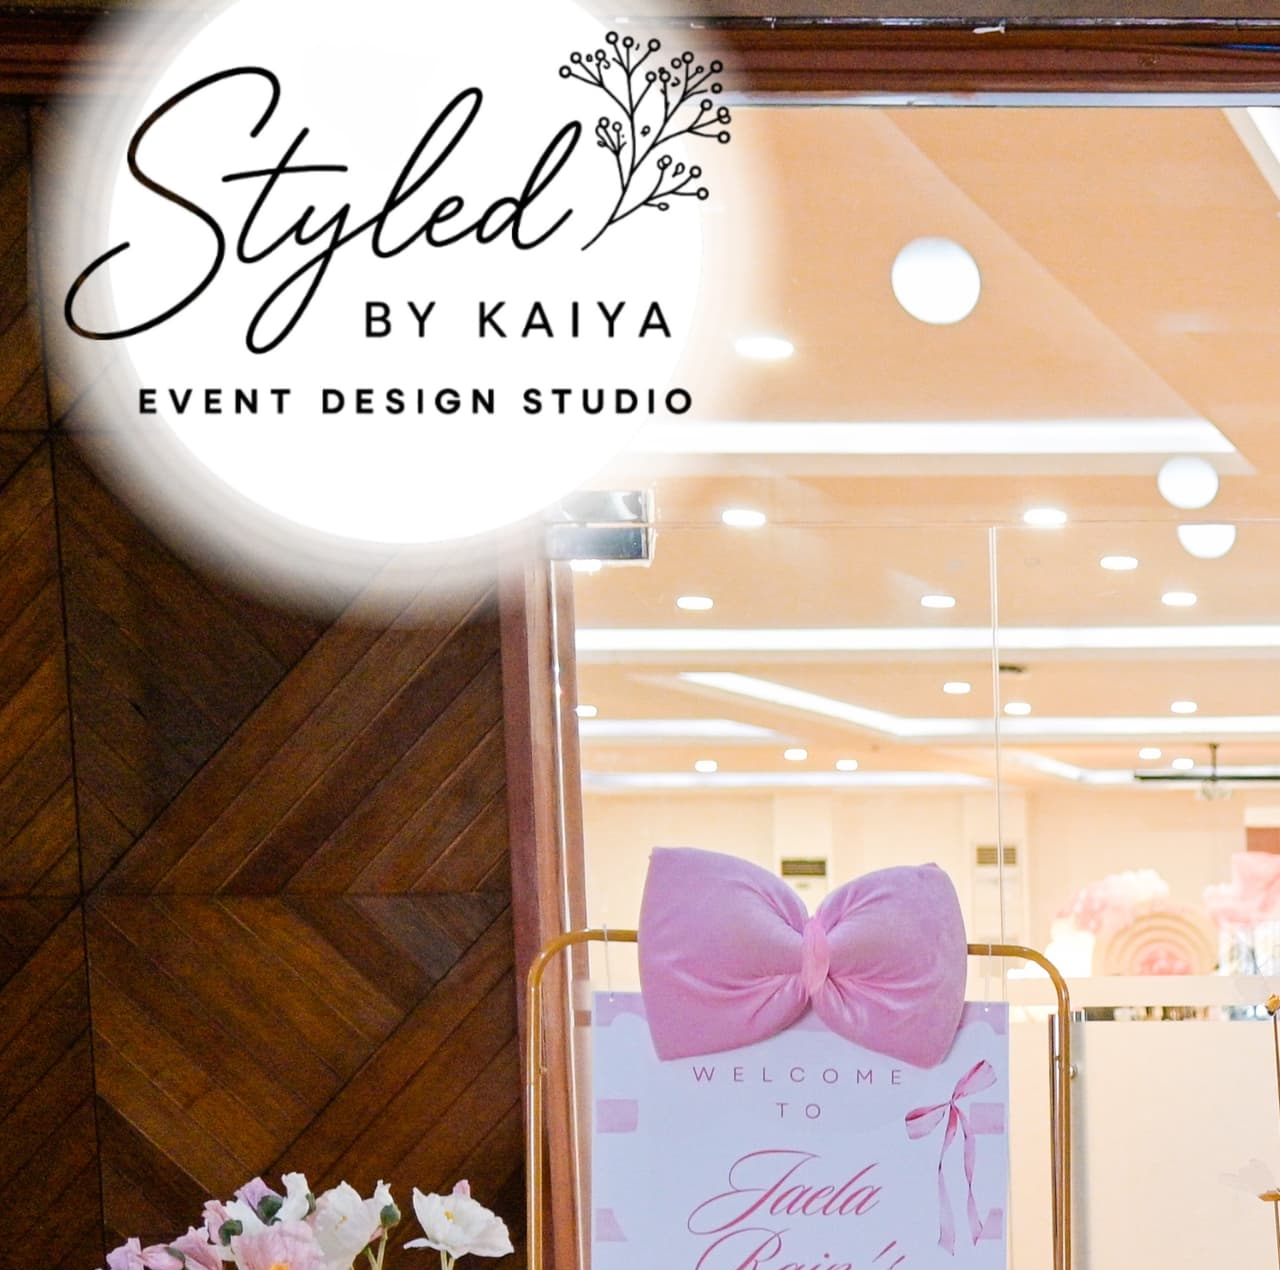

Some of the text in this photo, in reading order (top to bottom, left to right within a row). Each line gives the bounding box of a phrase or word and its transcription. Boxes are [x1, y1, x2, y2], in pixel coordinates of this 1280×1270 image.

[692, 1066, 903, 1085] WELCOME
[776, 1103, 821, 1120] TO
[687, 1149, 882, 1235] Jaela
